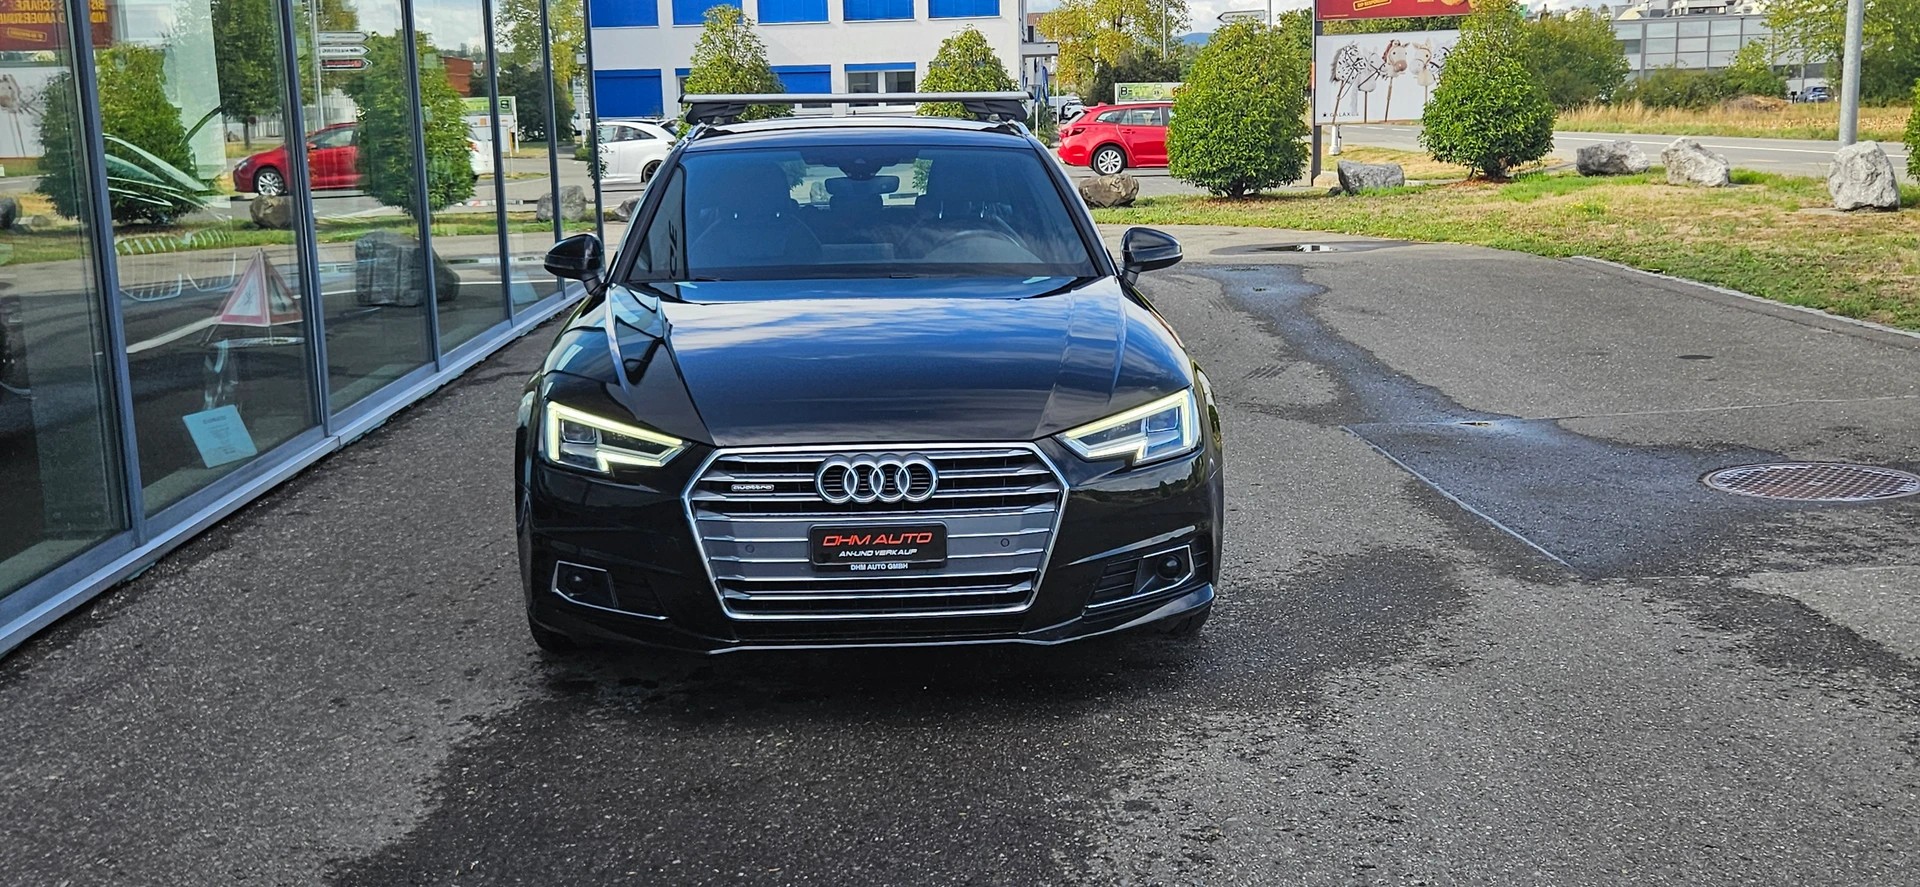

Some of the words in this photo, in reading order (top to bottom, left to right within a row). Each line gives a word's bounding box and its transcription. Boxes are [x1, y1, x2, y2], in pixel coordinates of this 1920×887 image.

[823, 535, 871, 546] DHM
[873, 532, 932, 544] AUTO
[875, 548, 918, 556] VERKAUF
